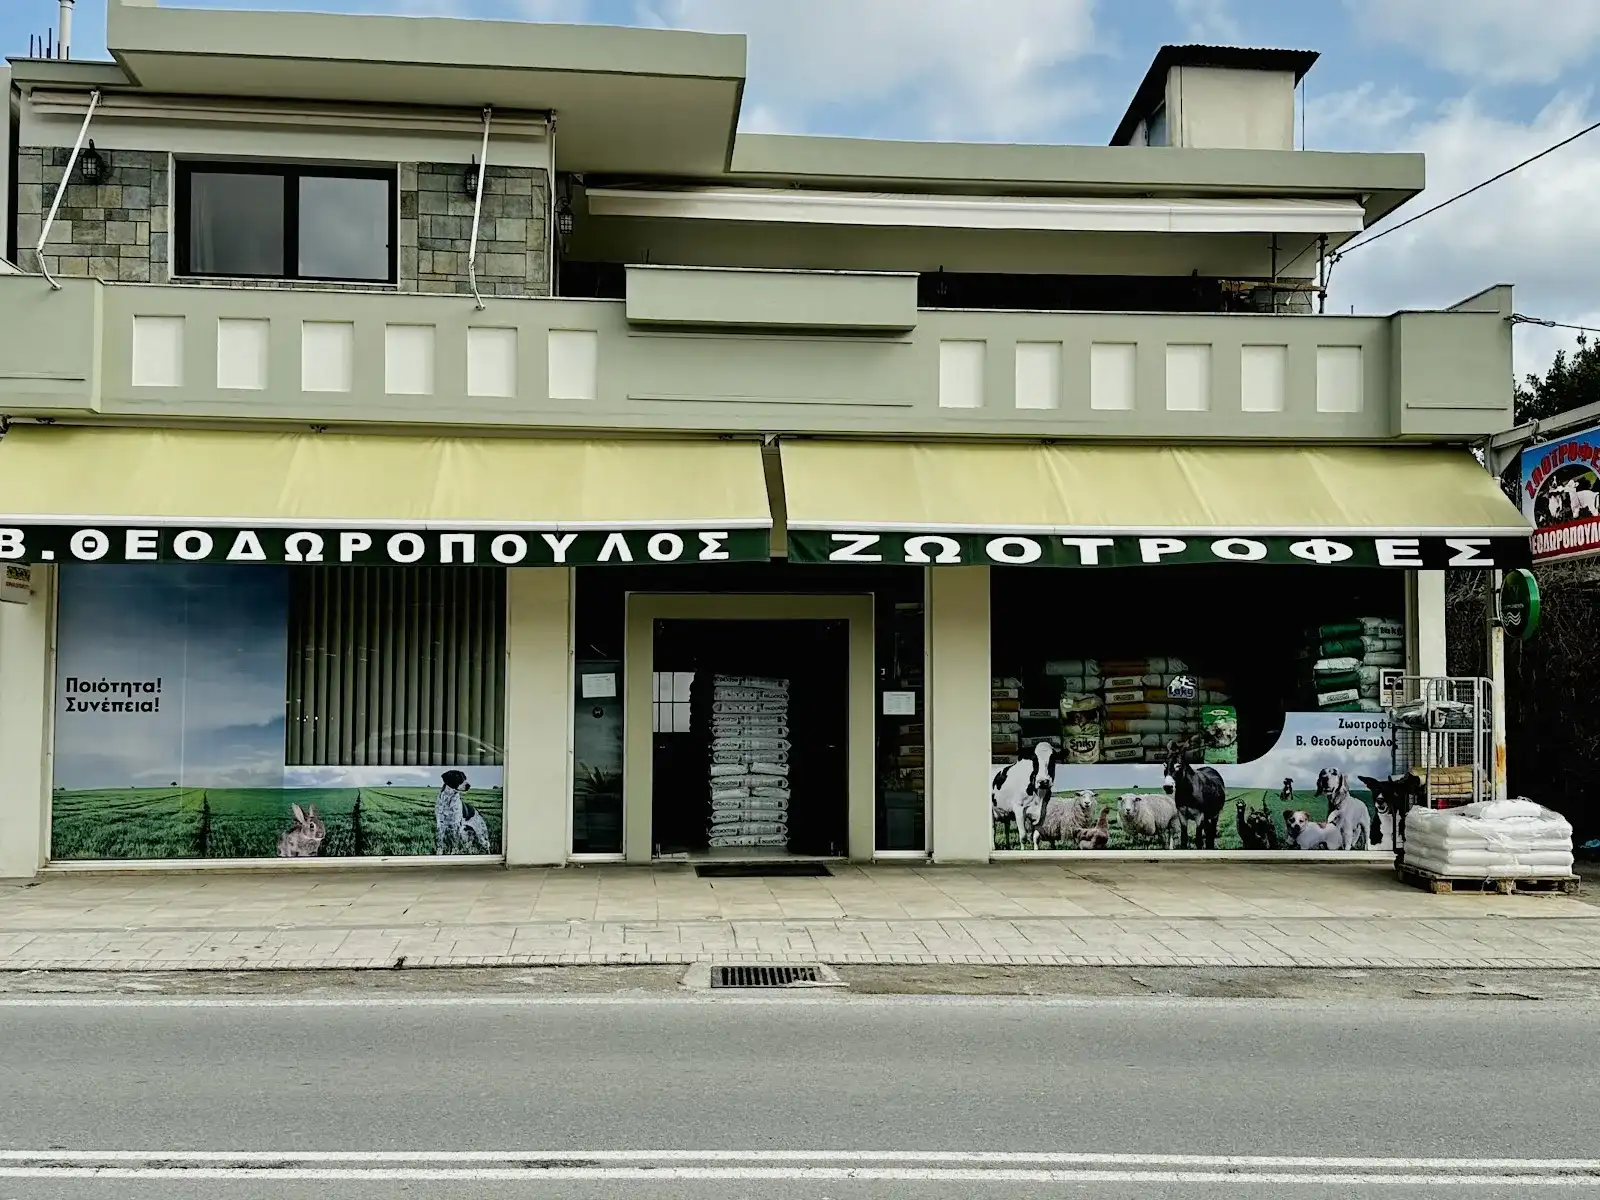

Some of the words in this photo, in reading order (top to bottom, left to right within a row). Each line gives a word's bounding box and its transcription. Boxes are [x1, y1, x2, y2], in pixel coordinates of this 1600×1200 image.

[829, 533, 1495, 567] ΖΩΟΤΡΟΦΕΣ
[66, 677, 162, 698] Ποιότητα!
[65, 696, 160, 713] Συνέπεια!
[1338, 718, 1395, 733] Ζωοτροφε
[1296, 735, 1307, 747] Β.
